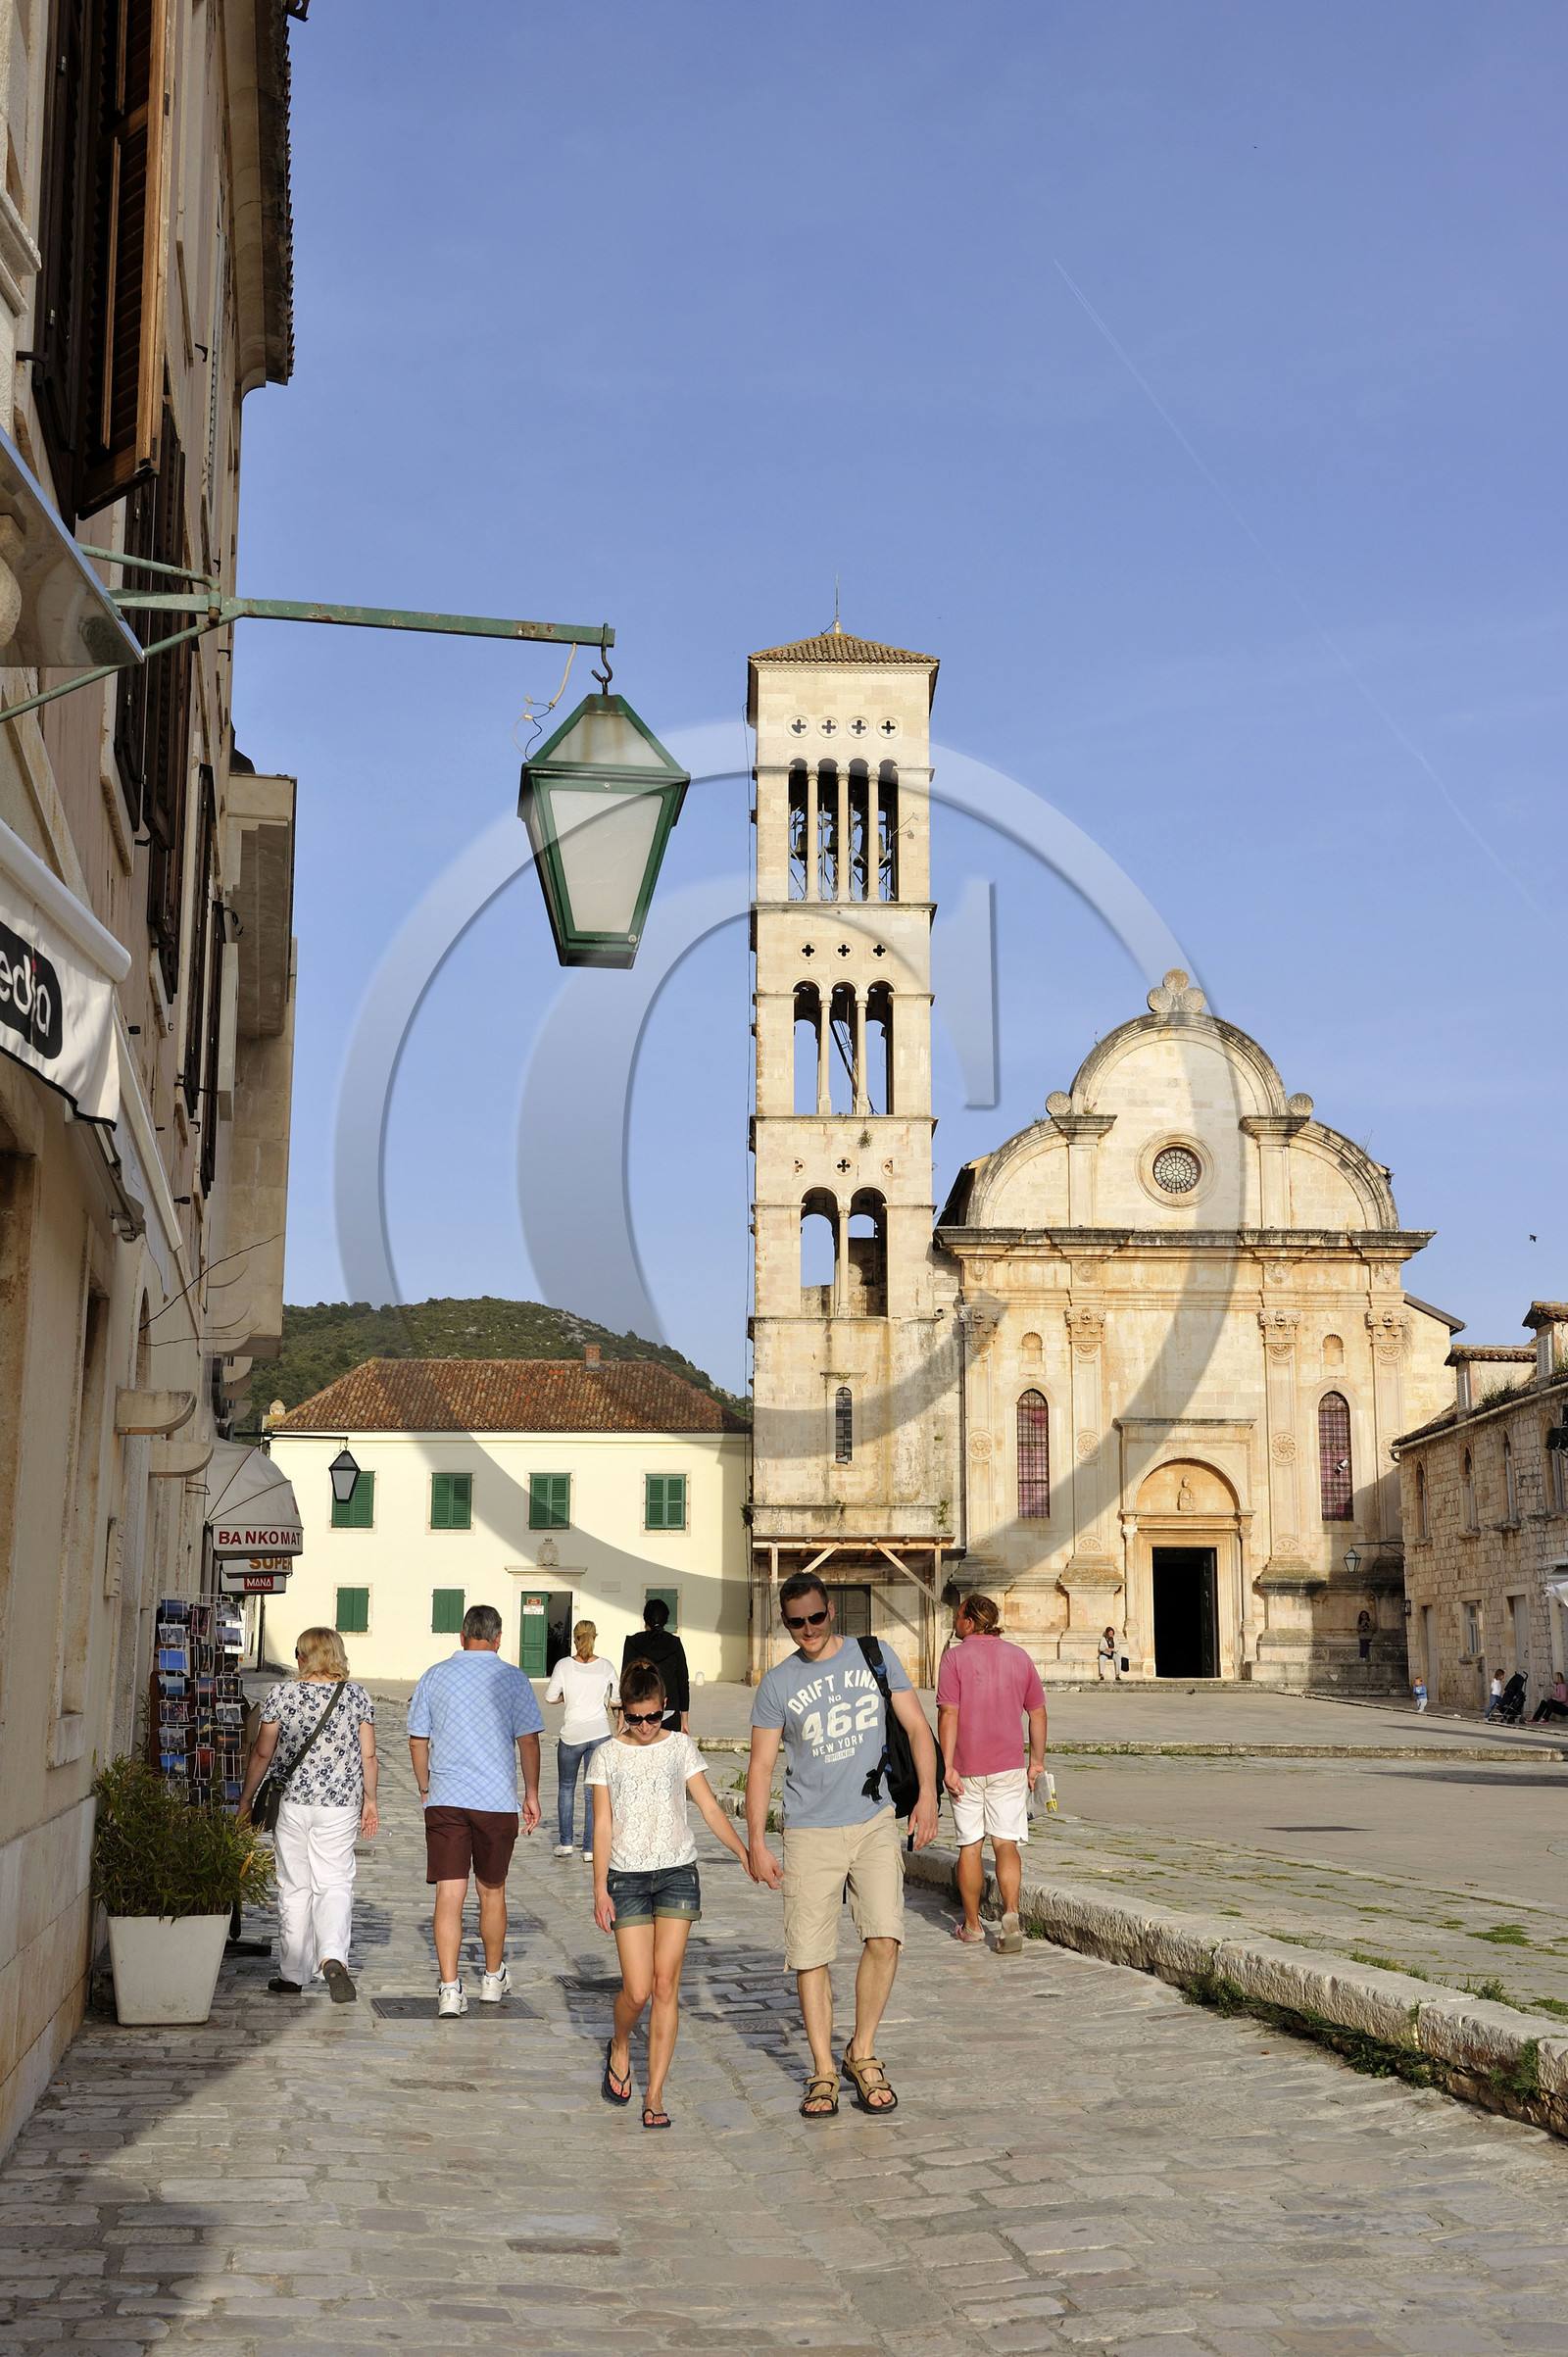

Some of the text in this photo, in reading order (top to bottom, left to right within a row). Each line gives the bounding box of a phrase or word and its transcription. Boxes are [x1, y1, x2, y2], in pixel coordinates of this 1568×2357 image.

[219, 1531, 300, 1546] BANKOMAT
[246, 1578, 271, 1587] MANA
[787, 1674, 835, 1715] DRIFT
[802, 1694, 879, 1746] 462
[812, 1733, 864, 1757] NEW YORK
[825, 1747, 856, 1763] ORIGINAL
